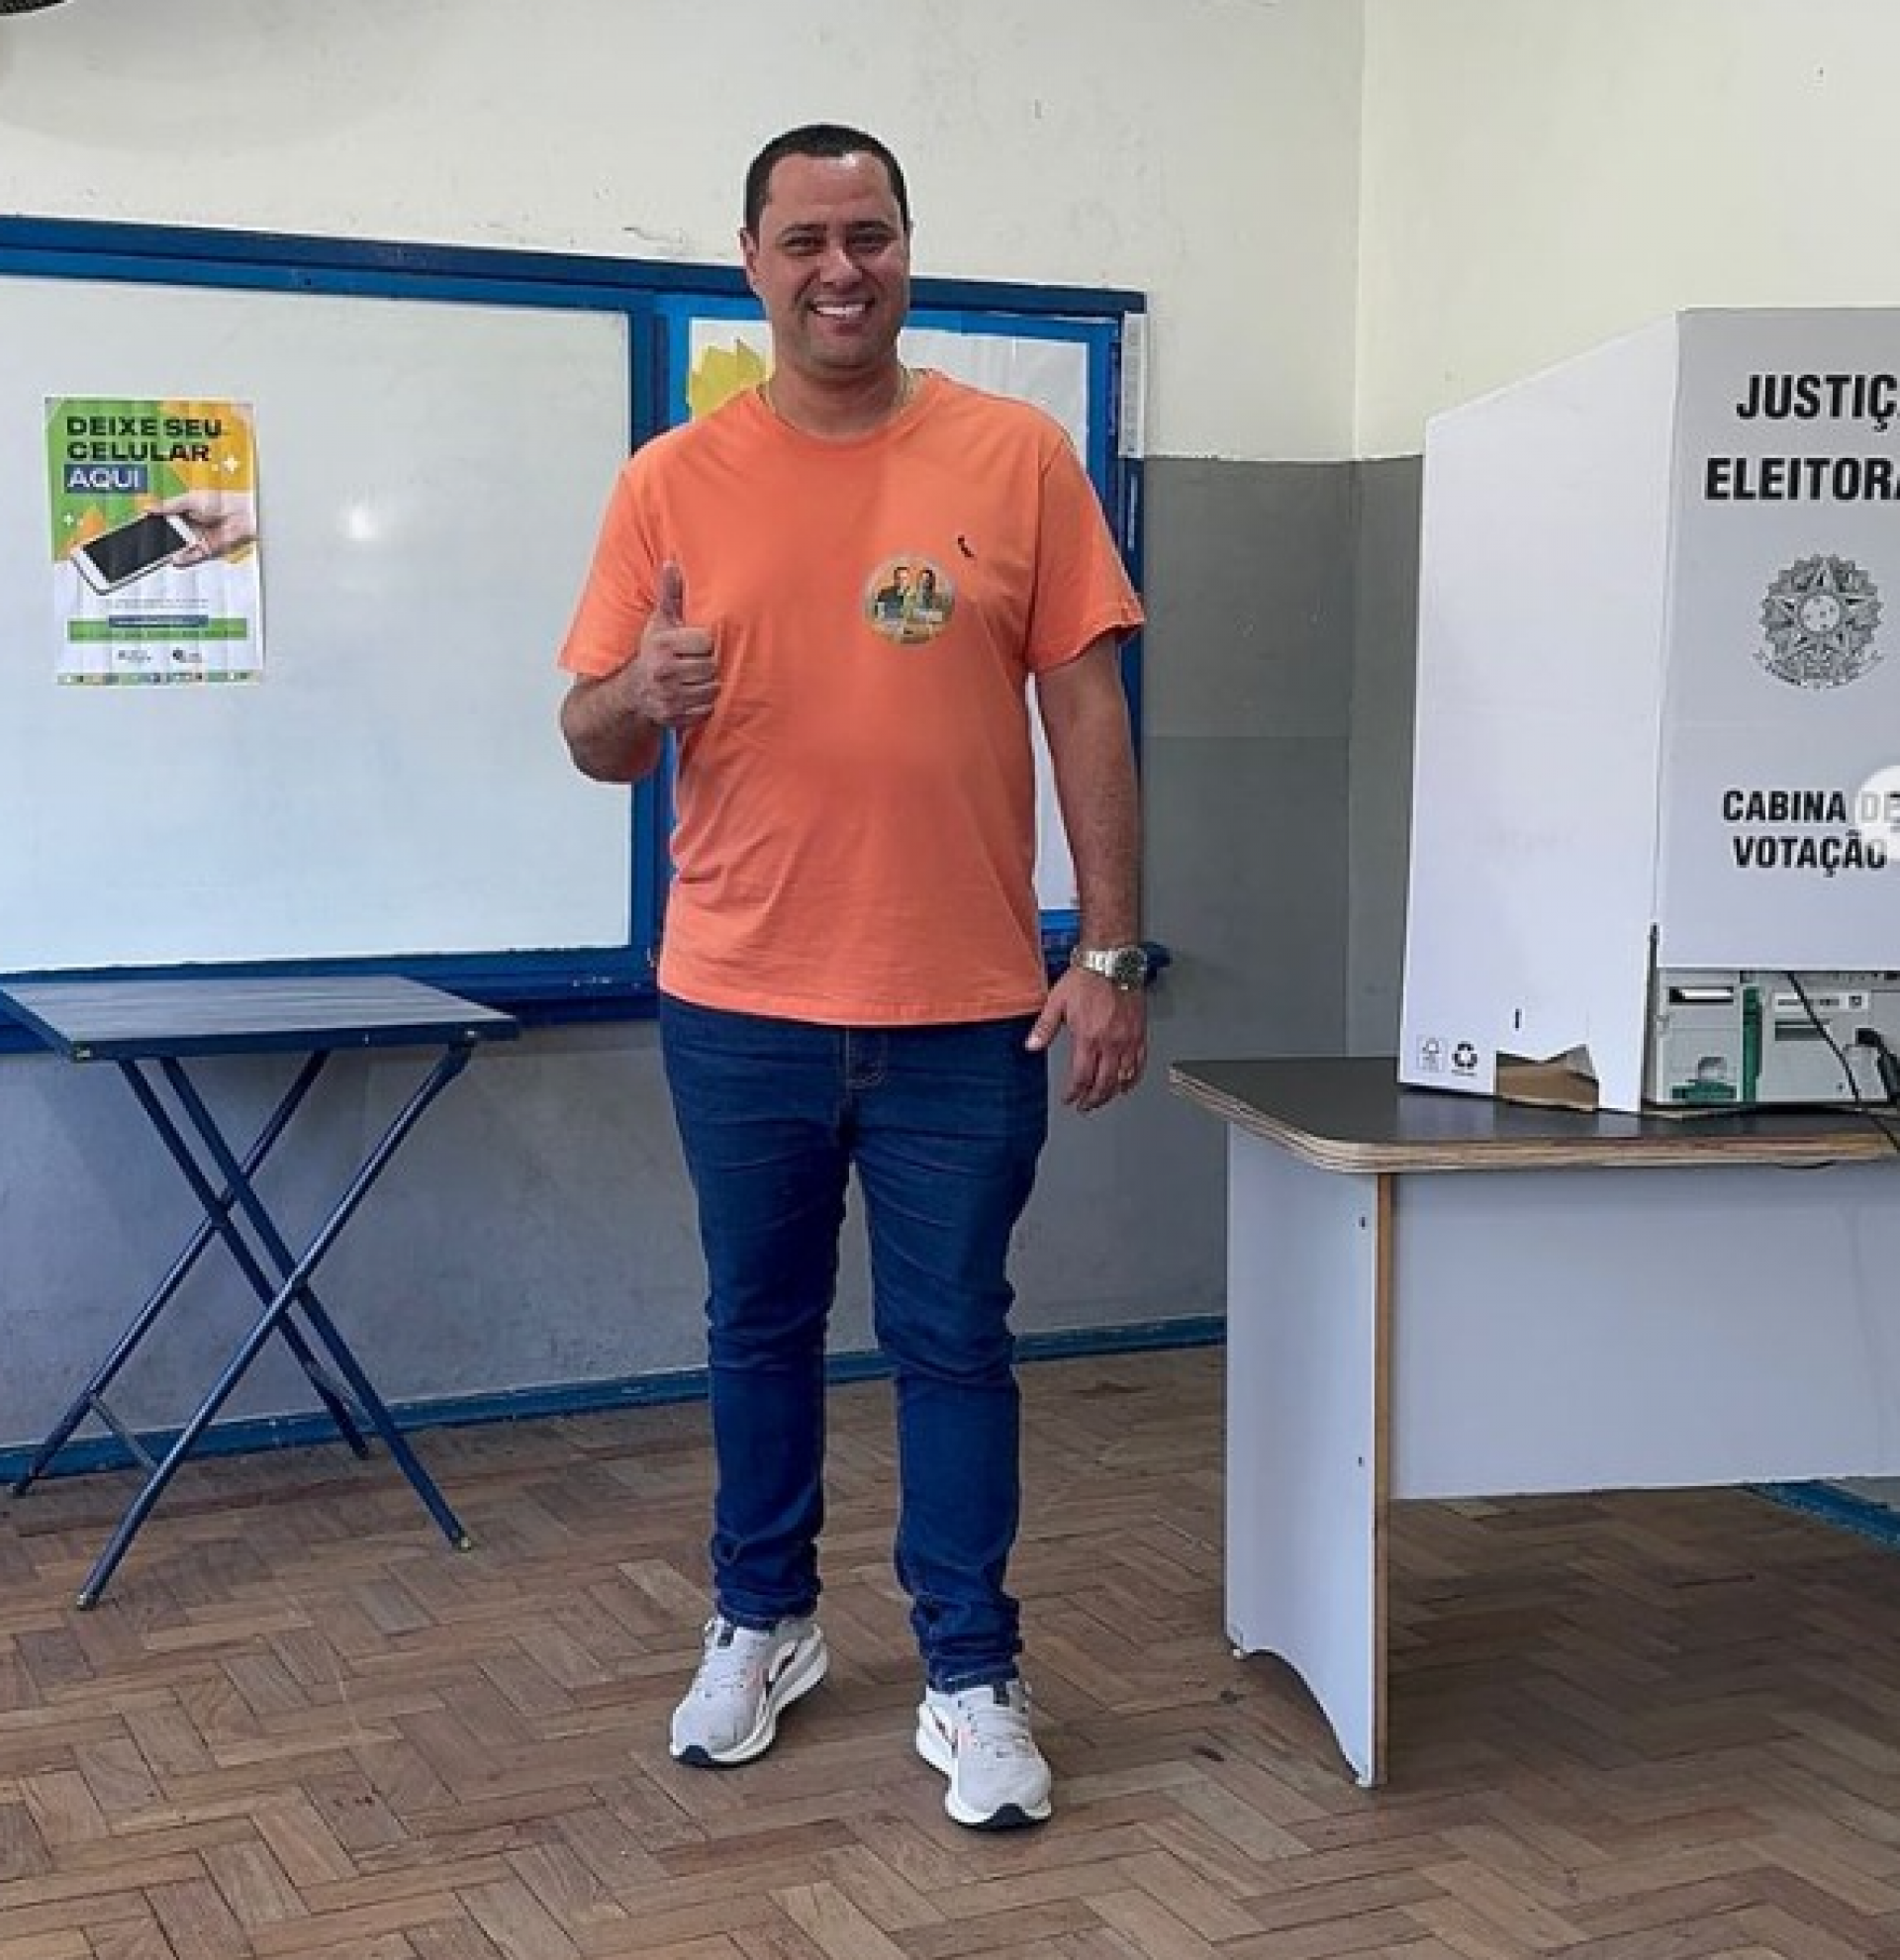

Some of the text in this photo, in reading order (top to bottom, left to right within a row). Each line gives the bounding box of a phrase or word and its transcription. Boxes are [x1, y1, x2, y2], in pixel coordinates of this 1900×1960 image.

[1737, 374, 1900, 432] JUSTIÇ
[66, 416, 223, 437] DEIXE SEU
[66, 441, 211, 462] CELULAR
[68, 467, 142, 488] AQUI
[1704, 457, 1900, 501] ELEITOR
[1723, 790, 1847, 823] CABINA
[1733, 829, 1887, 879] VOTAÇÃO
